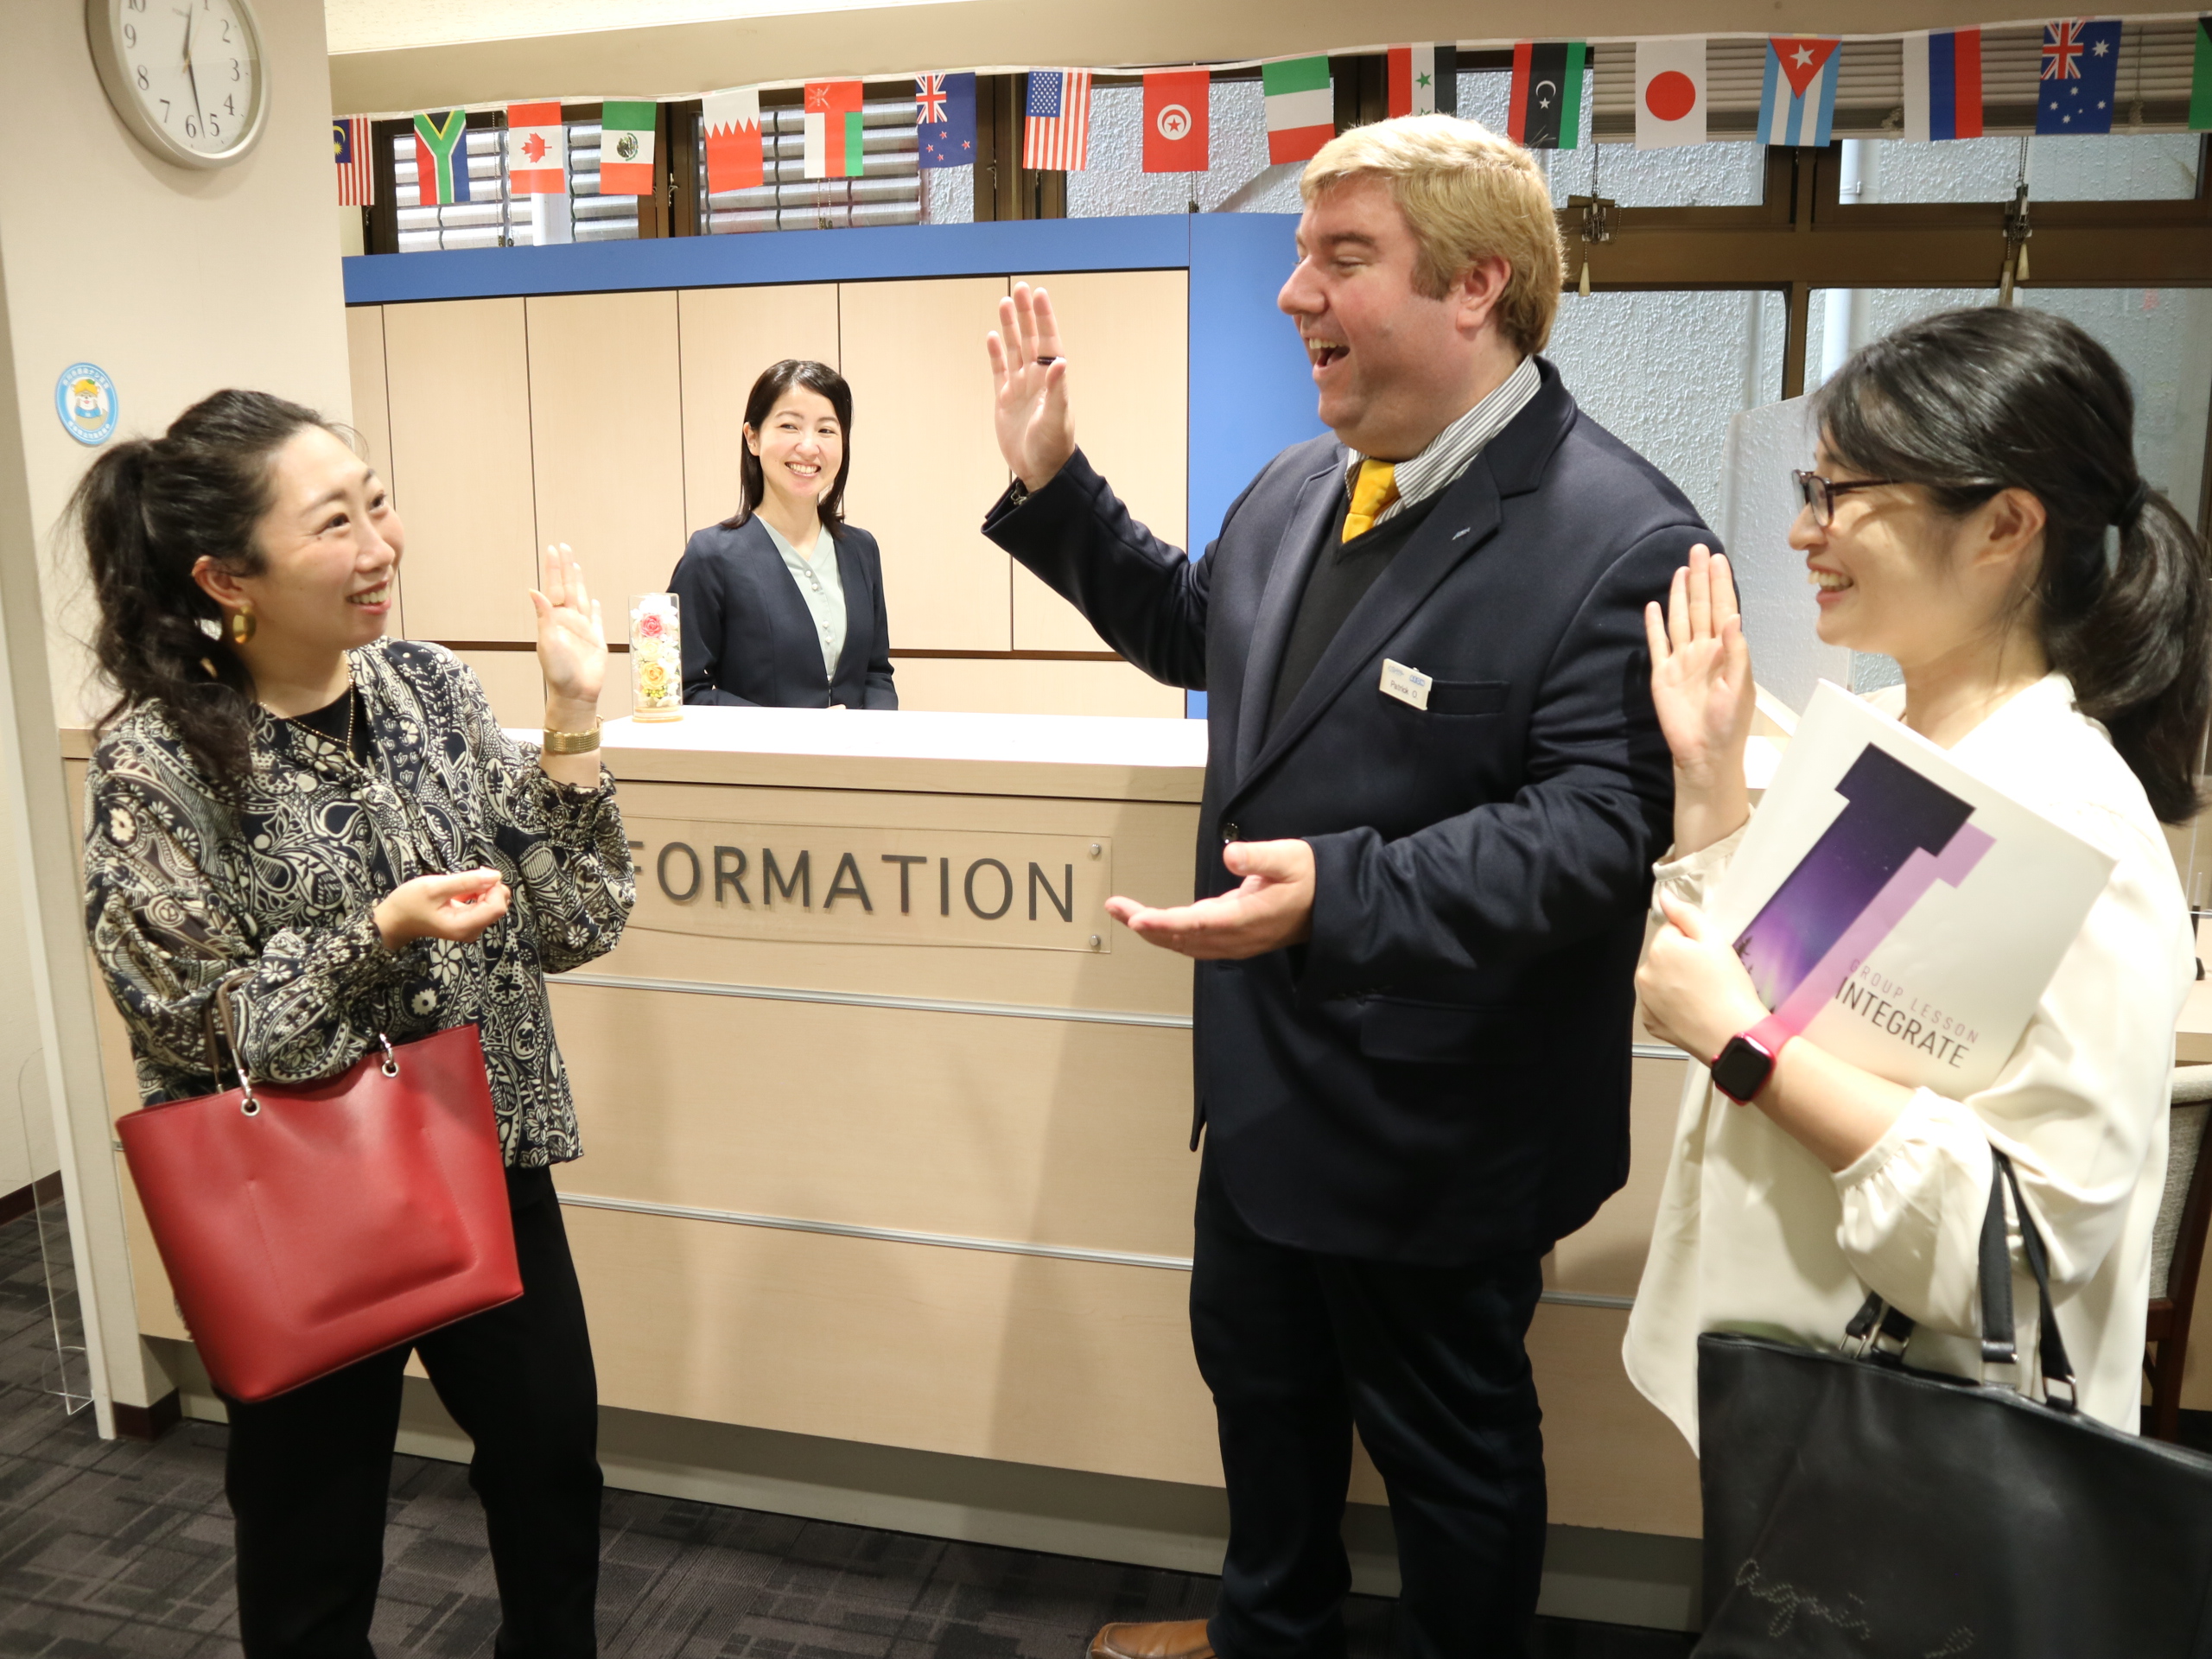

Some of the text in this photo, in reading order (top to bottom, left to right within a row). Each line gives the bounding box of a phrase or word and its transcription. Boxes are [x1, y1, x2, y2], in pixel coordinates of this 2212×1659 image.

[124, 23, 137, 48] 9
[220, 19, 231, 43] 2
[137, 65, 149, 90] 8
[229, 58, 239, 81] 3
[160, 99, 170, 123] 7
[224, 93, 234, 116] 4
[186, 115, 196, 138] 6
[210, 113, 219, 137] 5
[1849, 957, 1980, 1044] GROUP LESSON
[1834, 976, 1970, 1069] INTEGRATE
